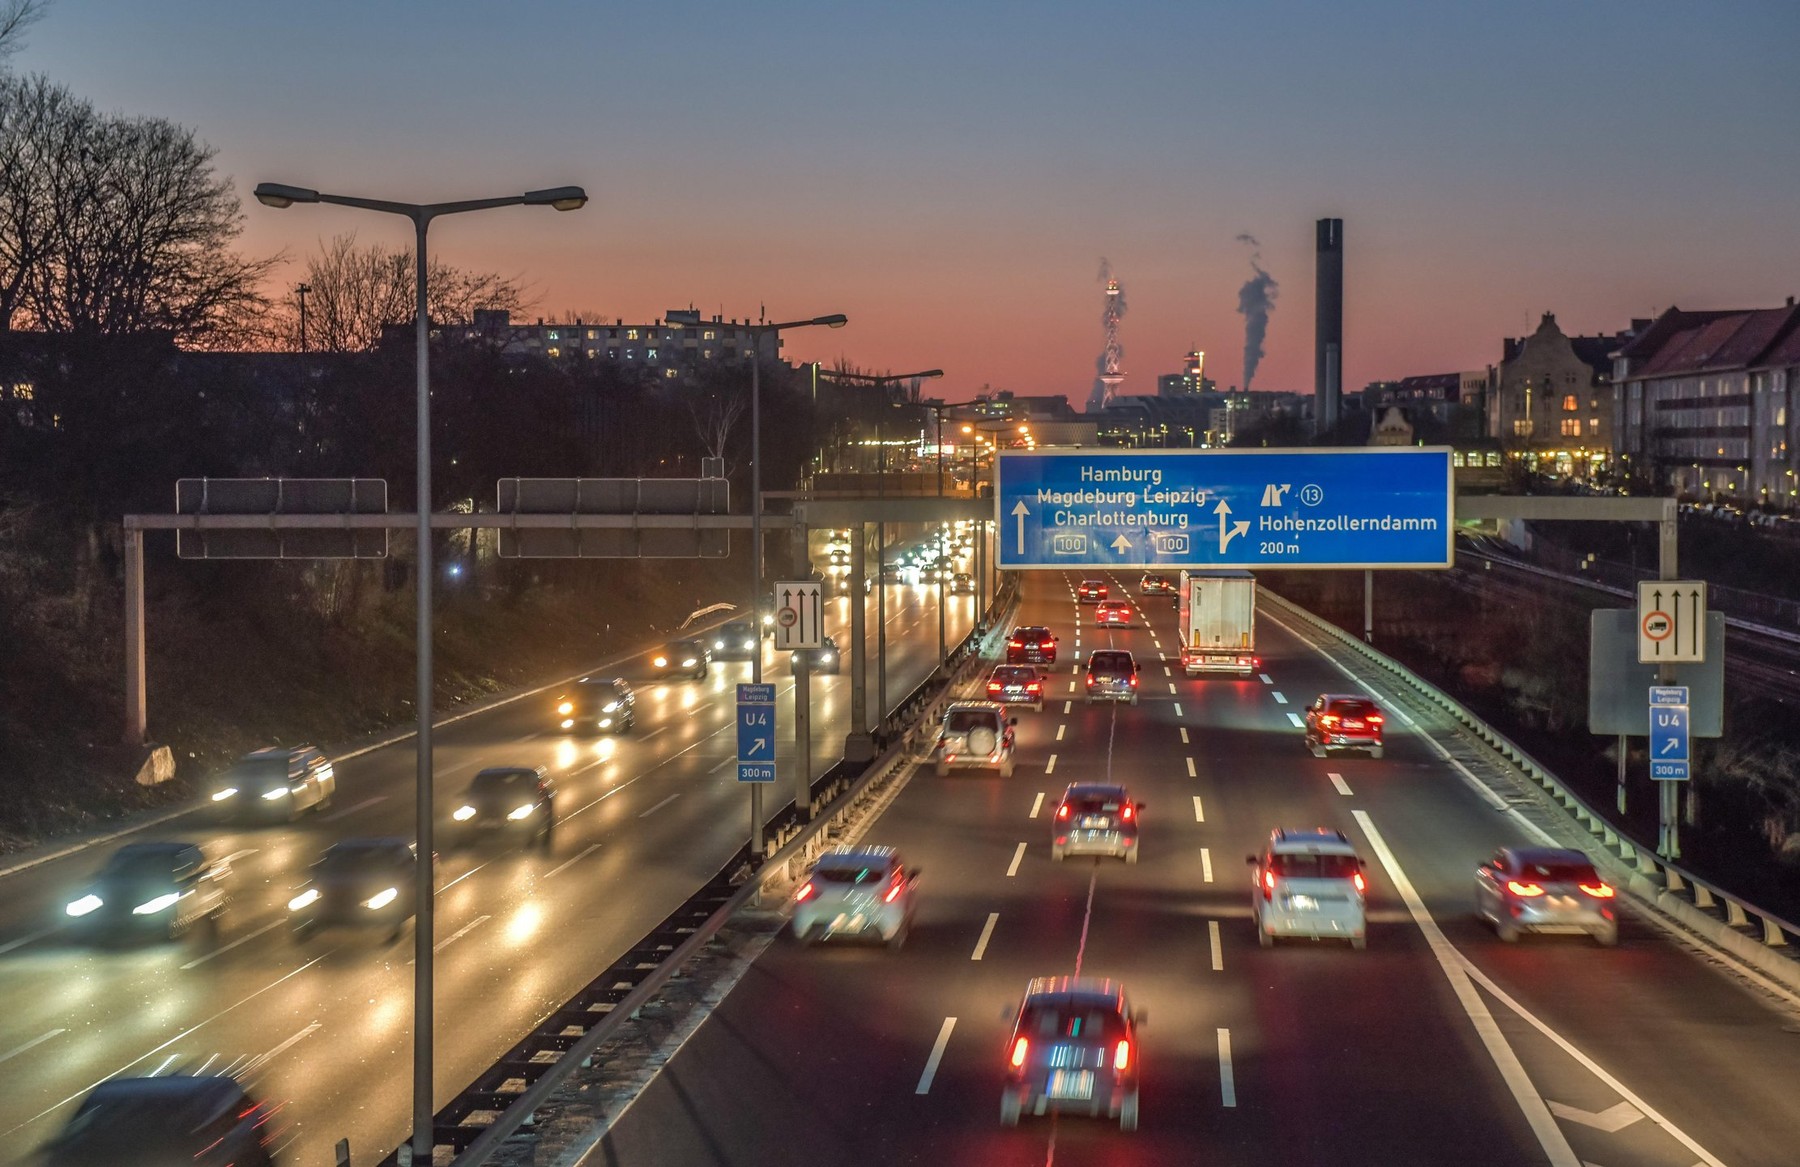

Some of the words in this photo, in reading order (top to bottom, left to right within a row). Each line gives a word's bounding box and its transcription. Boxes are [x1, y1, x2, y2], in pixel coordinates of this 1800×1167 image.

[1080, 466, 1162, 485] Hamburg
[1037, 488, 1136, 507] Magdeburg
[1144, 488, 1206, 507] Leipzig
[1305, 488, 1319, 502] 13
[1054, 510, 1189, 530] Charlottenburg
[1259, 515, 1438, 532] Hohenzollerndamm
[1060, 537, 1081, 551] 100
[1162, 536, 1183, 550] 100
[1259, 541, 1284, 555] 200
[1287, 545, 1300, 554] m
[743, 686, 769, 694] Magdeburg
[742, 768, 760, 778] 300
[761, 769, 771, 778] m
[1656, 766, 1673, 774] 300
